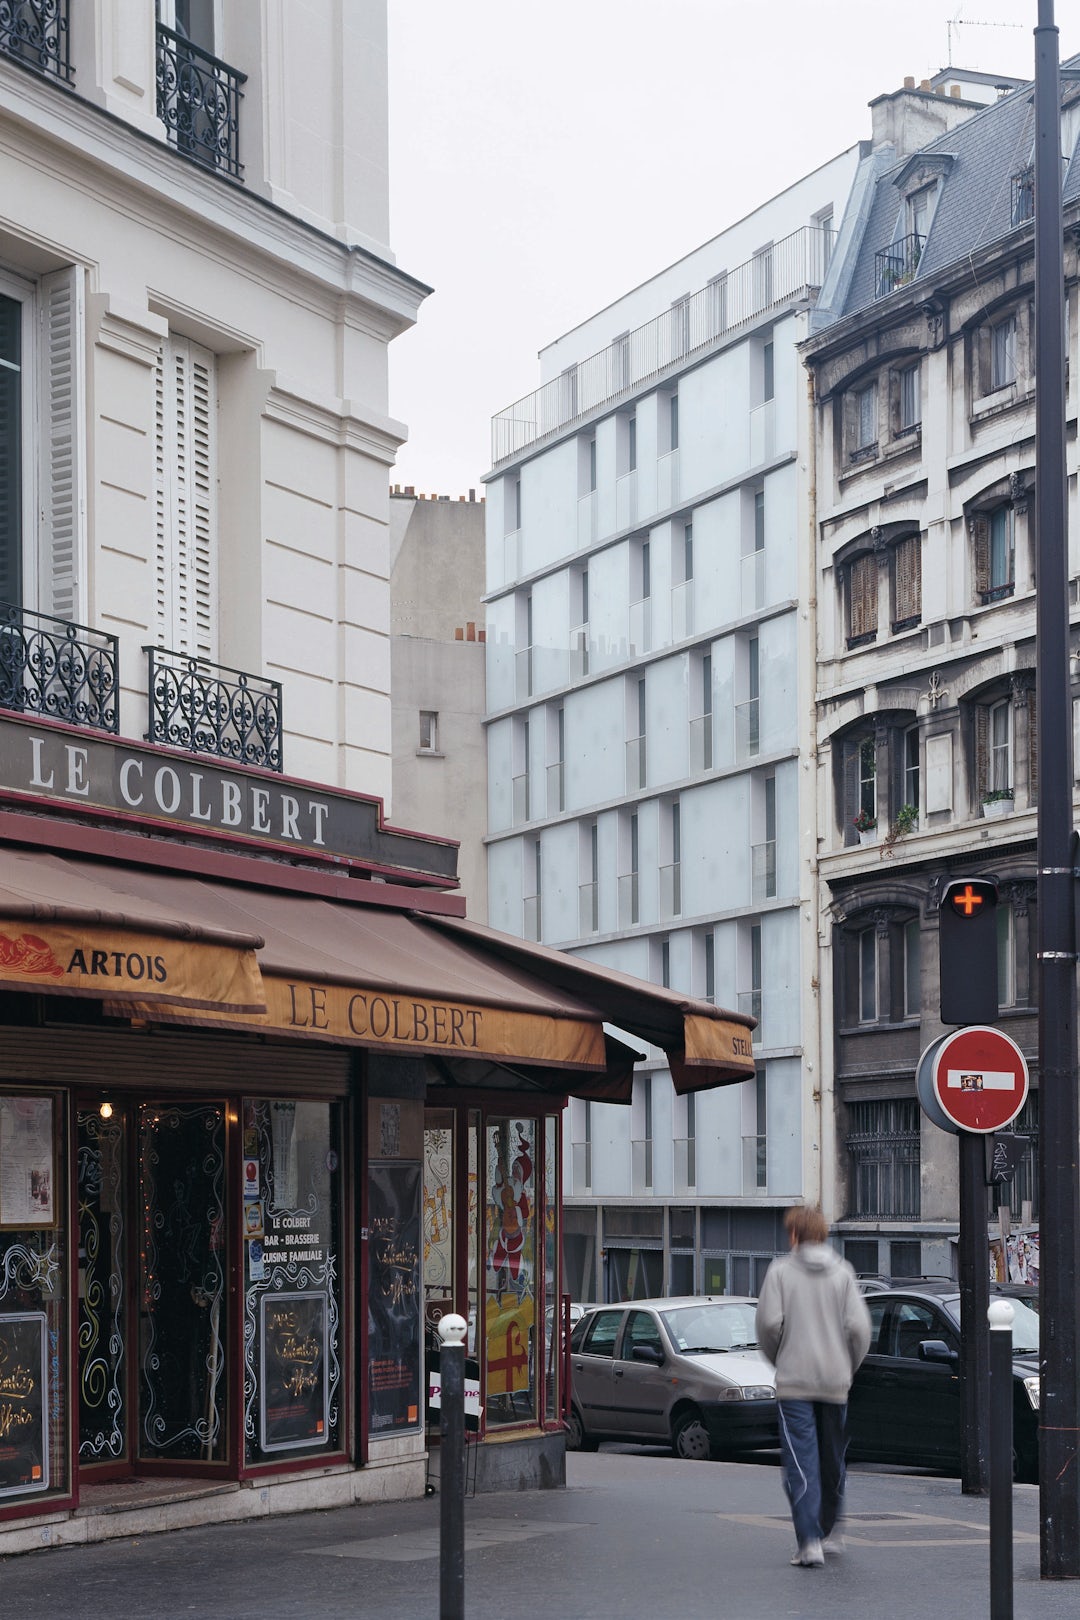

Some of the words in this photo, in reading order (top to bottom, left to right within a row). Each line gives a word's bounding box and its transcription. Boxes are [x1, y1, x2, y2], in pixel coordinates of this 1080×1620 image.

[28, 736, 90, 796] LE
[119, 758, 329, 846] COLBERT
[66, 948, 168, 983] ARTOIS
[287, 984, 330, 1030] LE
[348, 994, 483, 1048] COLBERT
[272, 1218, 281, 1229] LE
[282, 1217, 311, 1228] COLBERT
[264, 1235, 279, 1246] BAR
[285, 1233, 320, 1245] BRASSERIE
[262, 1251, 288, 1263] CUISINE
[289, 1250, 323, 1261] FAMILIALE
